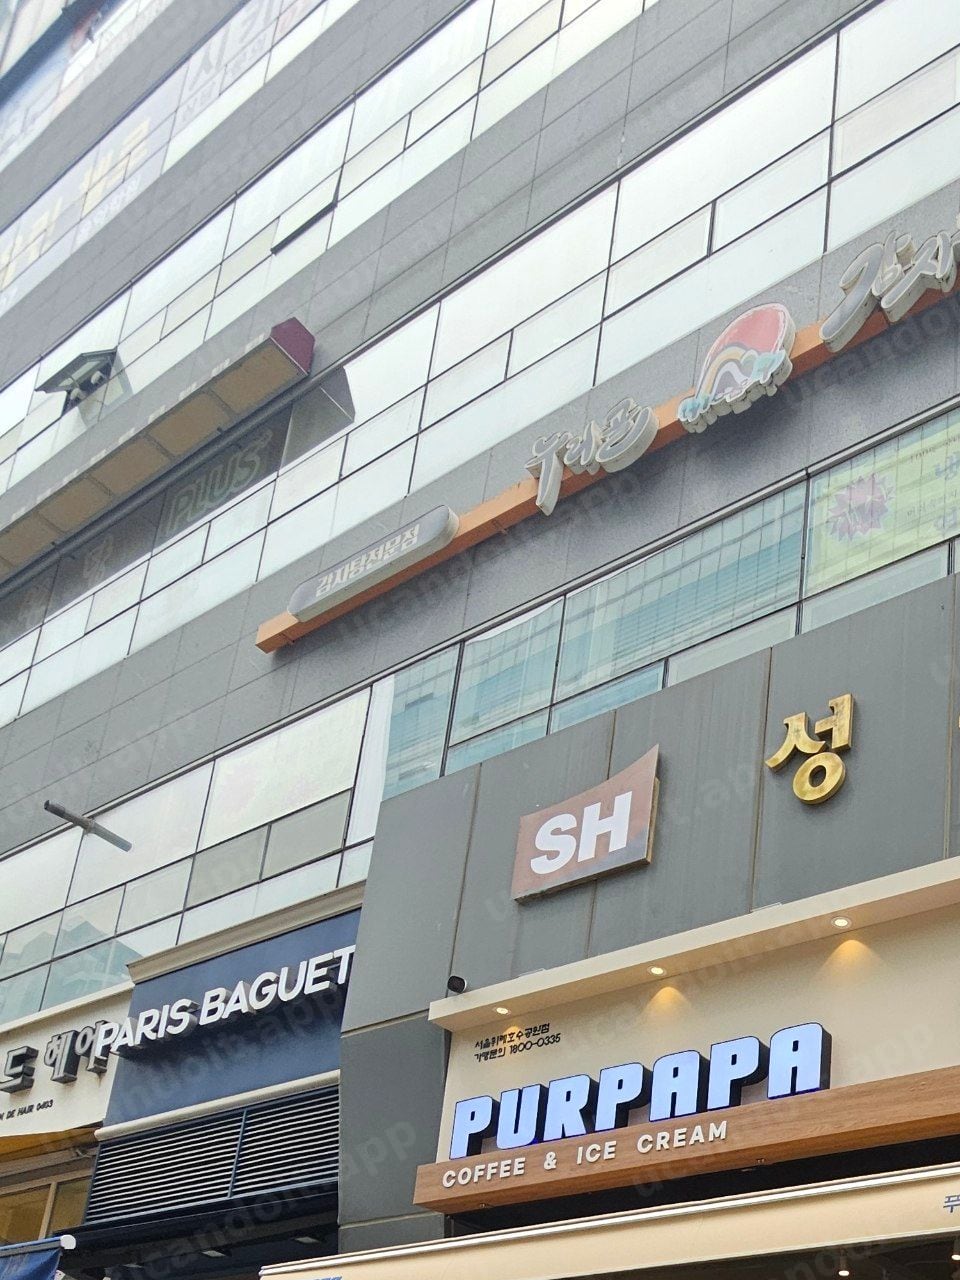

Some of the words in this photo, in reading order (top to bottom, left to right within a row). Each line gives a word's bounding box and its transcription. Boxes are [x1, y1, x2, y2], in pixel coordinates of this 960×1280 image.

[316, 524, 420, 597] 감자탕전문점
[529, 791, 632, 876] SH
[96, 999, 196, 1053] PARIS
[199, 945, 356, 1025] BAGUET
[509, 1033, 561, 1054] 1800-0335
[449, 1022, 828, 1160] PURPAPA
[442, 1157, 526, 1189] COFFEE
[543, 1151, 557, 1170] &
[576, 1141, 617, 1165] ICE
[637, 1120, 728, 1154] CREAM
